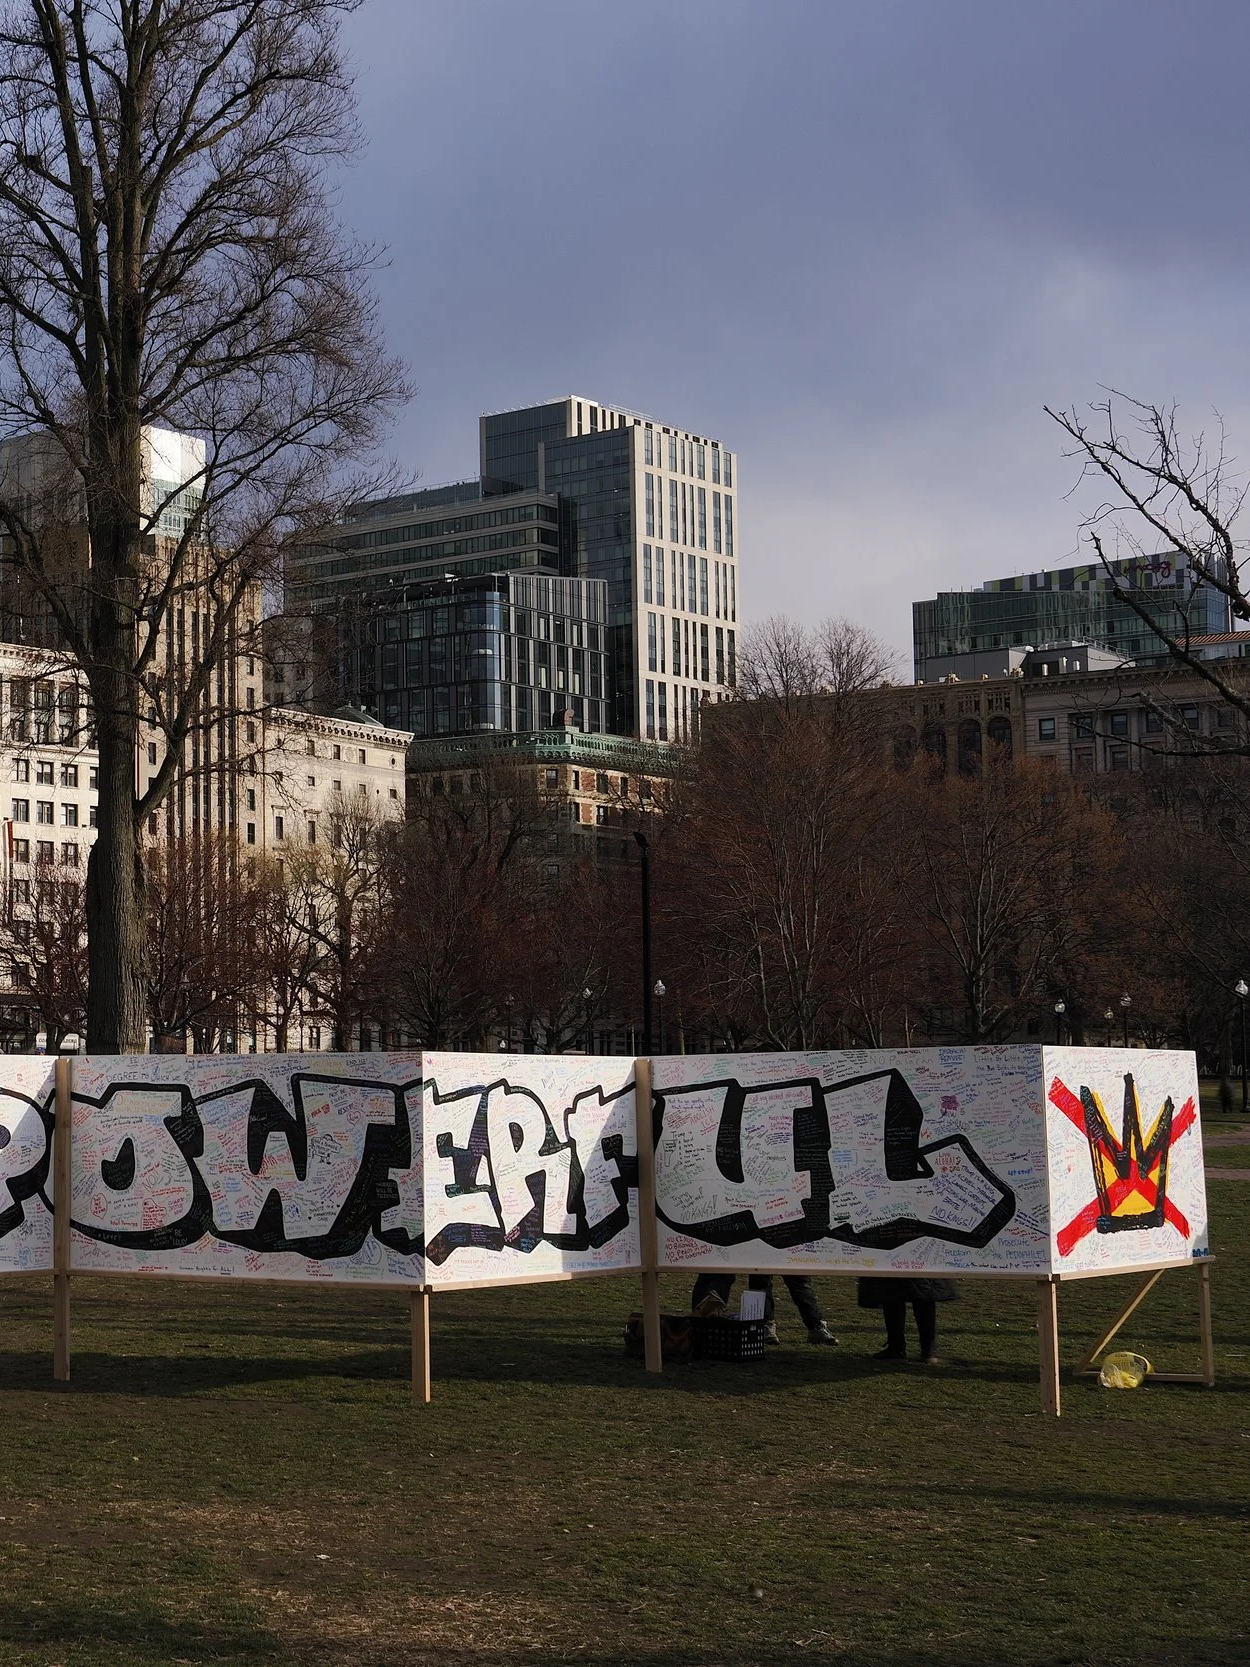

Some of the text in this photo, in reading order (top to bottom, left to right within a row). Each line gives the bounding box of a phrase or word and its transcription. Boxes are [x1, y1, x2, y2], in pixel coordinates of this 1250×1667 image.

[106, 1071, 139, 1082] DEGREE
[931, 1205, 946, 1219] NO
[998, 1238, 1030, 1247] Prosecute
